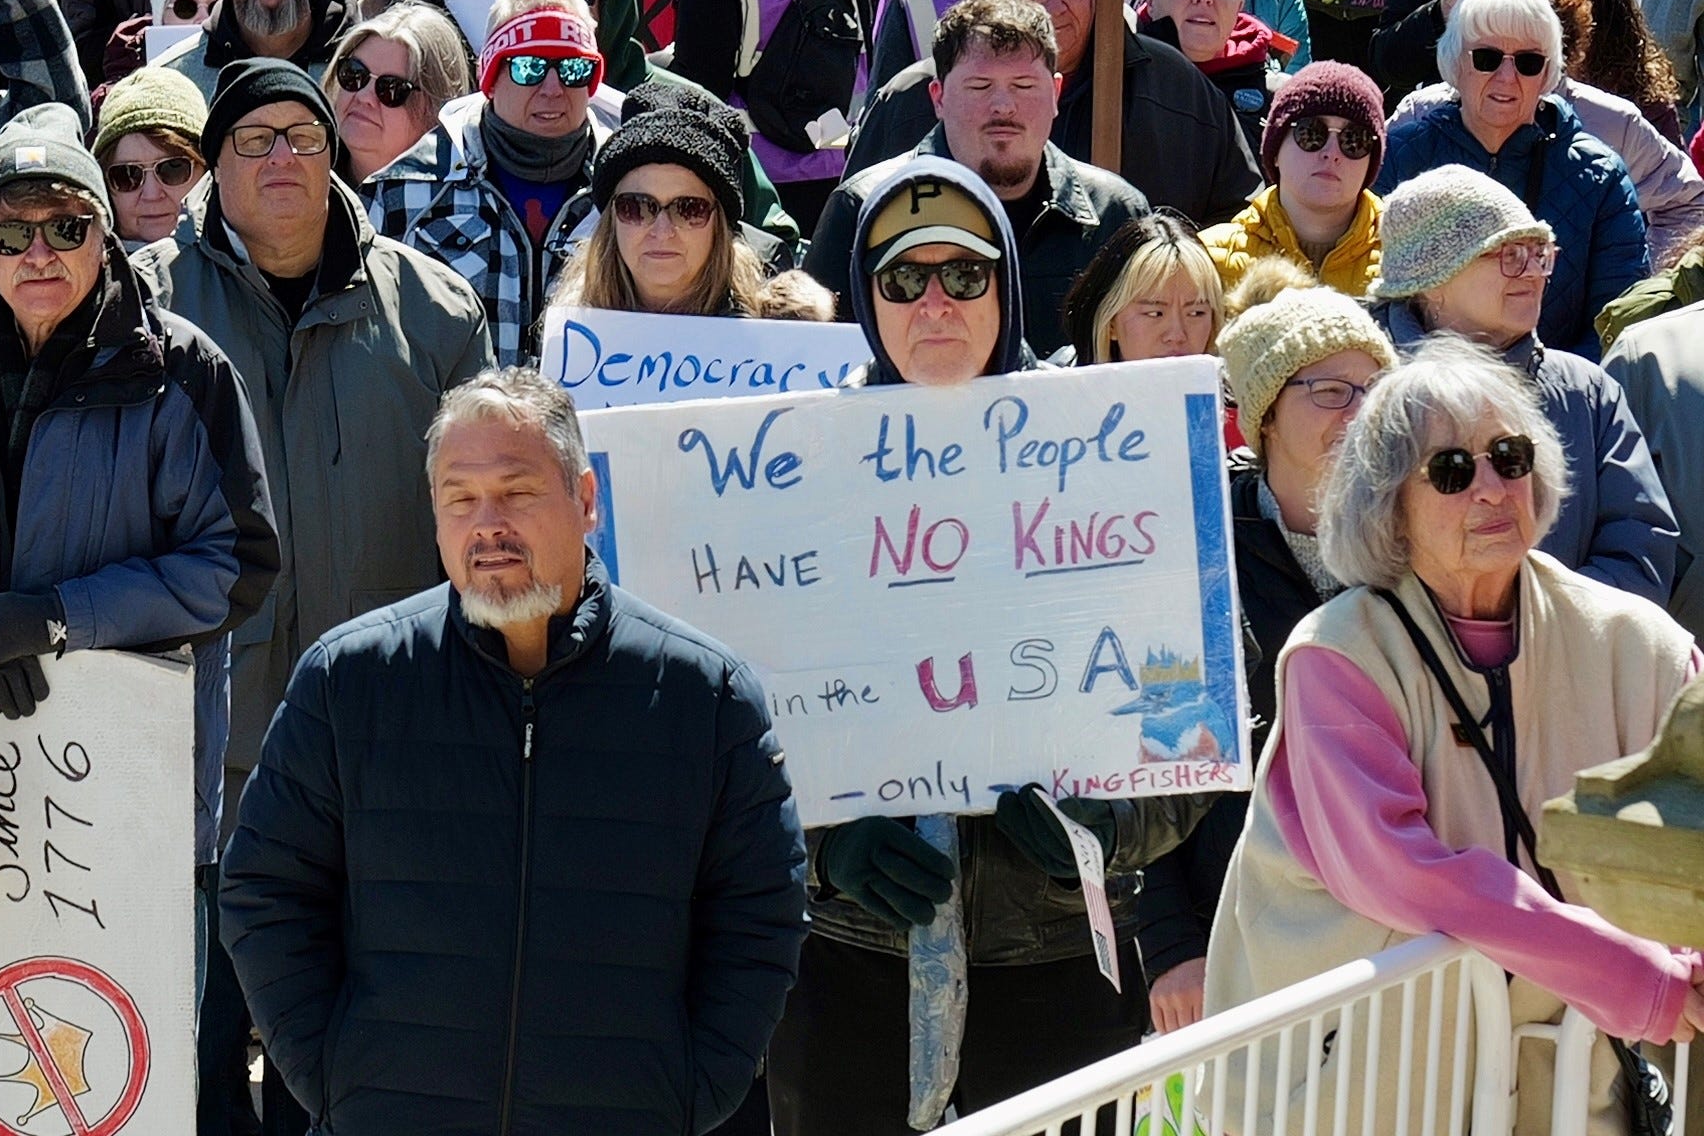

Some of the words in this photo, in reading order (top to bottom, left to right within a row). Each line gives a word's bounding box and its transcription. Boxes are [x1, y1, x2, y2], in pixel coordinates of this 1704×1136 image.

[903, 179, 944, 215] P
[678, 406, 804, 499] We
[861, 412, 966, 482] the
[985, 394, 1150, 493] People
[691, 542, 822, 595] HAVE
[869, 503, 971, 580] NO
[1011, 495, 1160, 572] KINGS
[772, 689, 808, 717] in
[818, 677, 881, 707] the
[878, 760, 972, 805] only
[1052, 760, 1239, 801] KINGFISHERS
[36, 733, 107, 930] 1776
